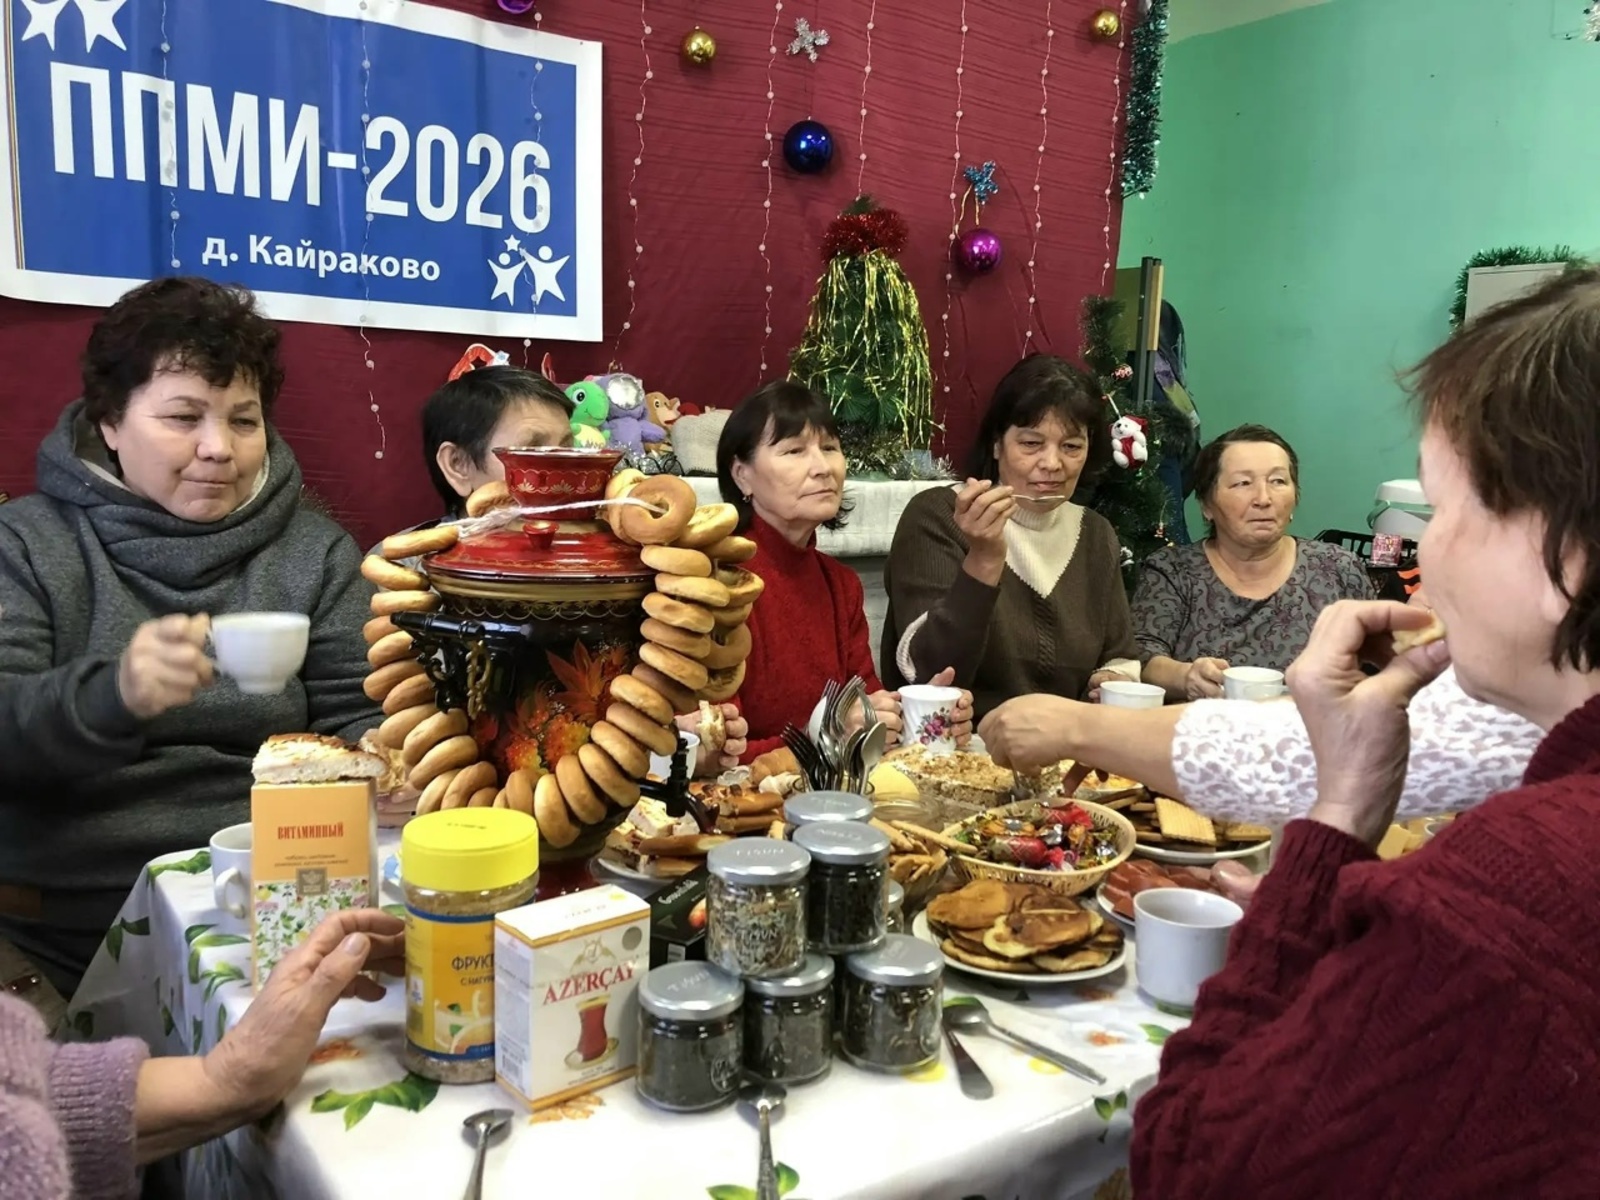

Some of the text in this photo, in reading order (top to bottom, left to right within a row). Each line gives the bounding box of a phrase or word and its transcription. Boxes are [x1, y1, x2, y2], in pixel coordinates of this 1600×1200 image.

[50, 61, 551, 234] ППМИ-2026
[202, 234, 440, 281] д. Кайраково
[277, 822, 344, 840] ВИТАМИННЫЙ
[543, 959, 637, 1005] AZERÇAY
